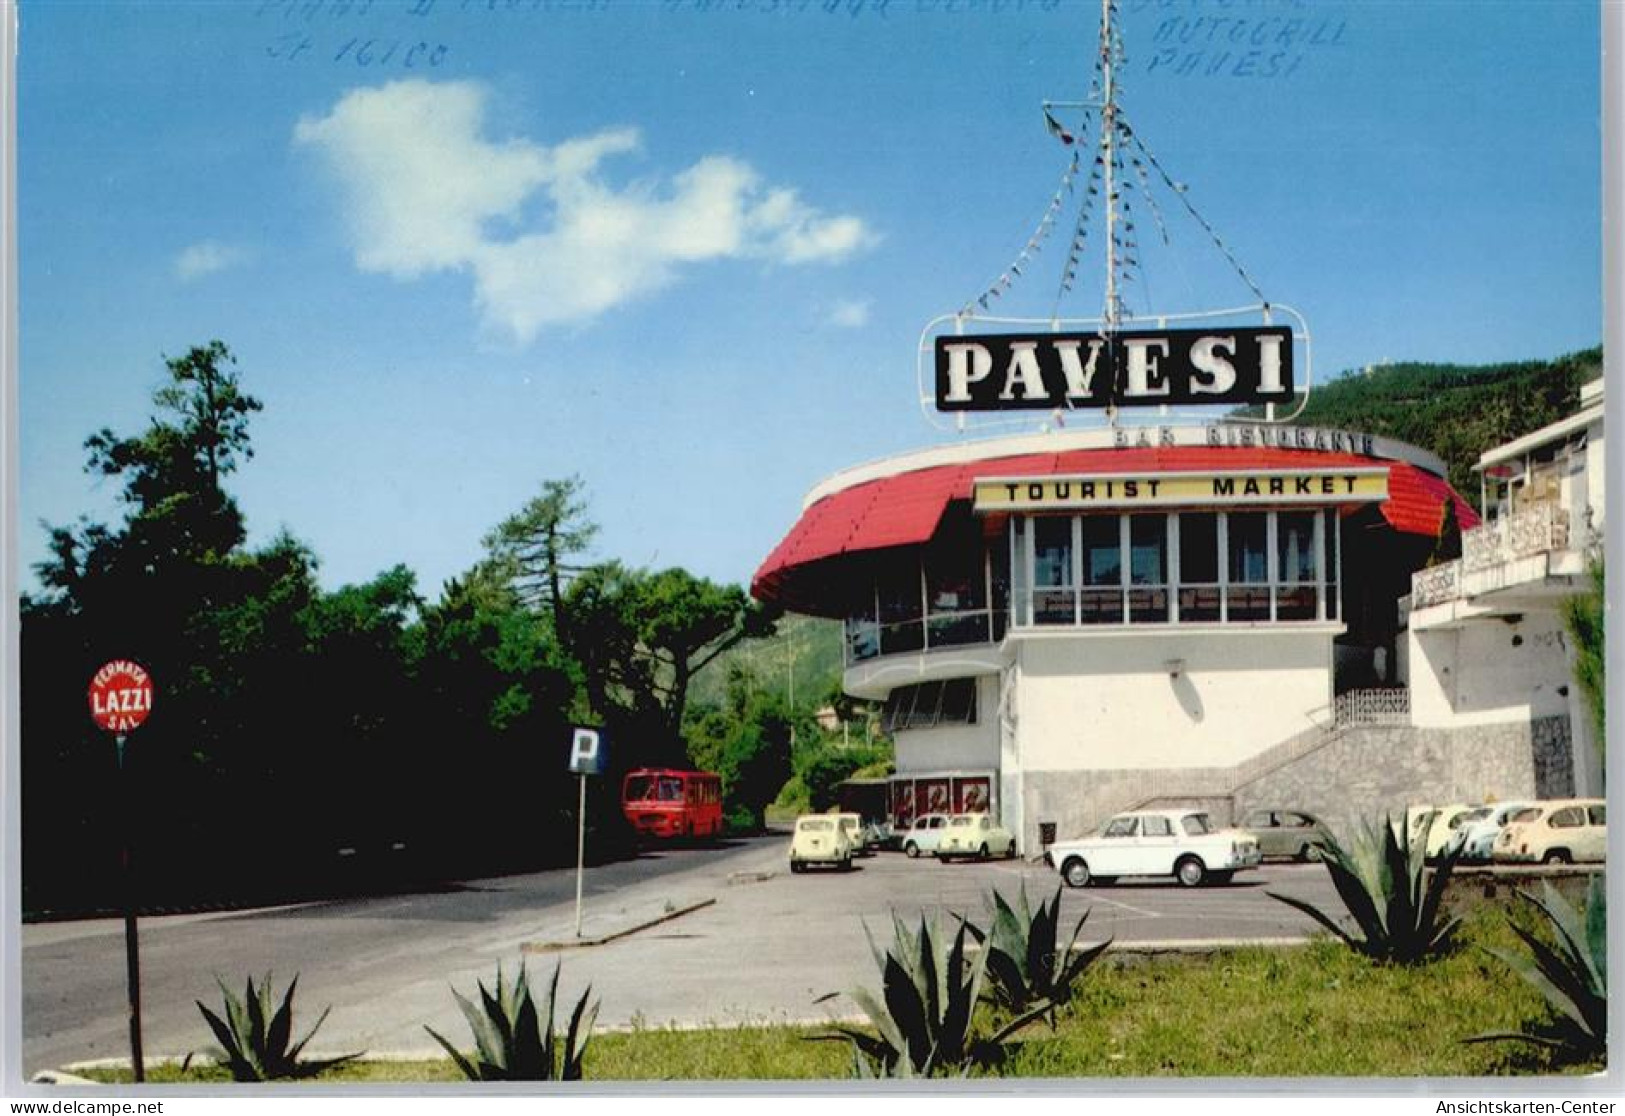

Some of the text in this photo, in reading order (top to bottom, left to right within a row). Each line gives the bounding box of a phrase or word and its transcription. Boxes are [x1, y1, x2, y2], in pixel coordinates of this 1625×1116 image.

[1146, 47, 1303, 77] PAVESI
[943, 334, 1286, 403] PAVESI
[1112, 426, 1176, 448] BAR
[1005, 475, 1358, 502] TOURIST MARKET
[93, 687, 152, 714] LAZZI
[570, 727, 600, 770] P
